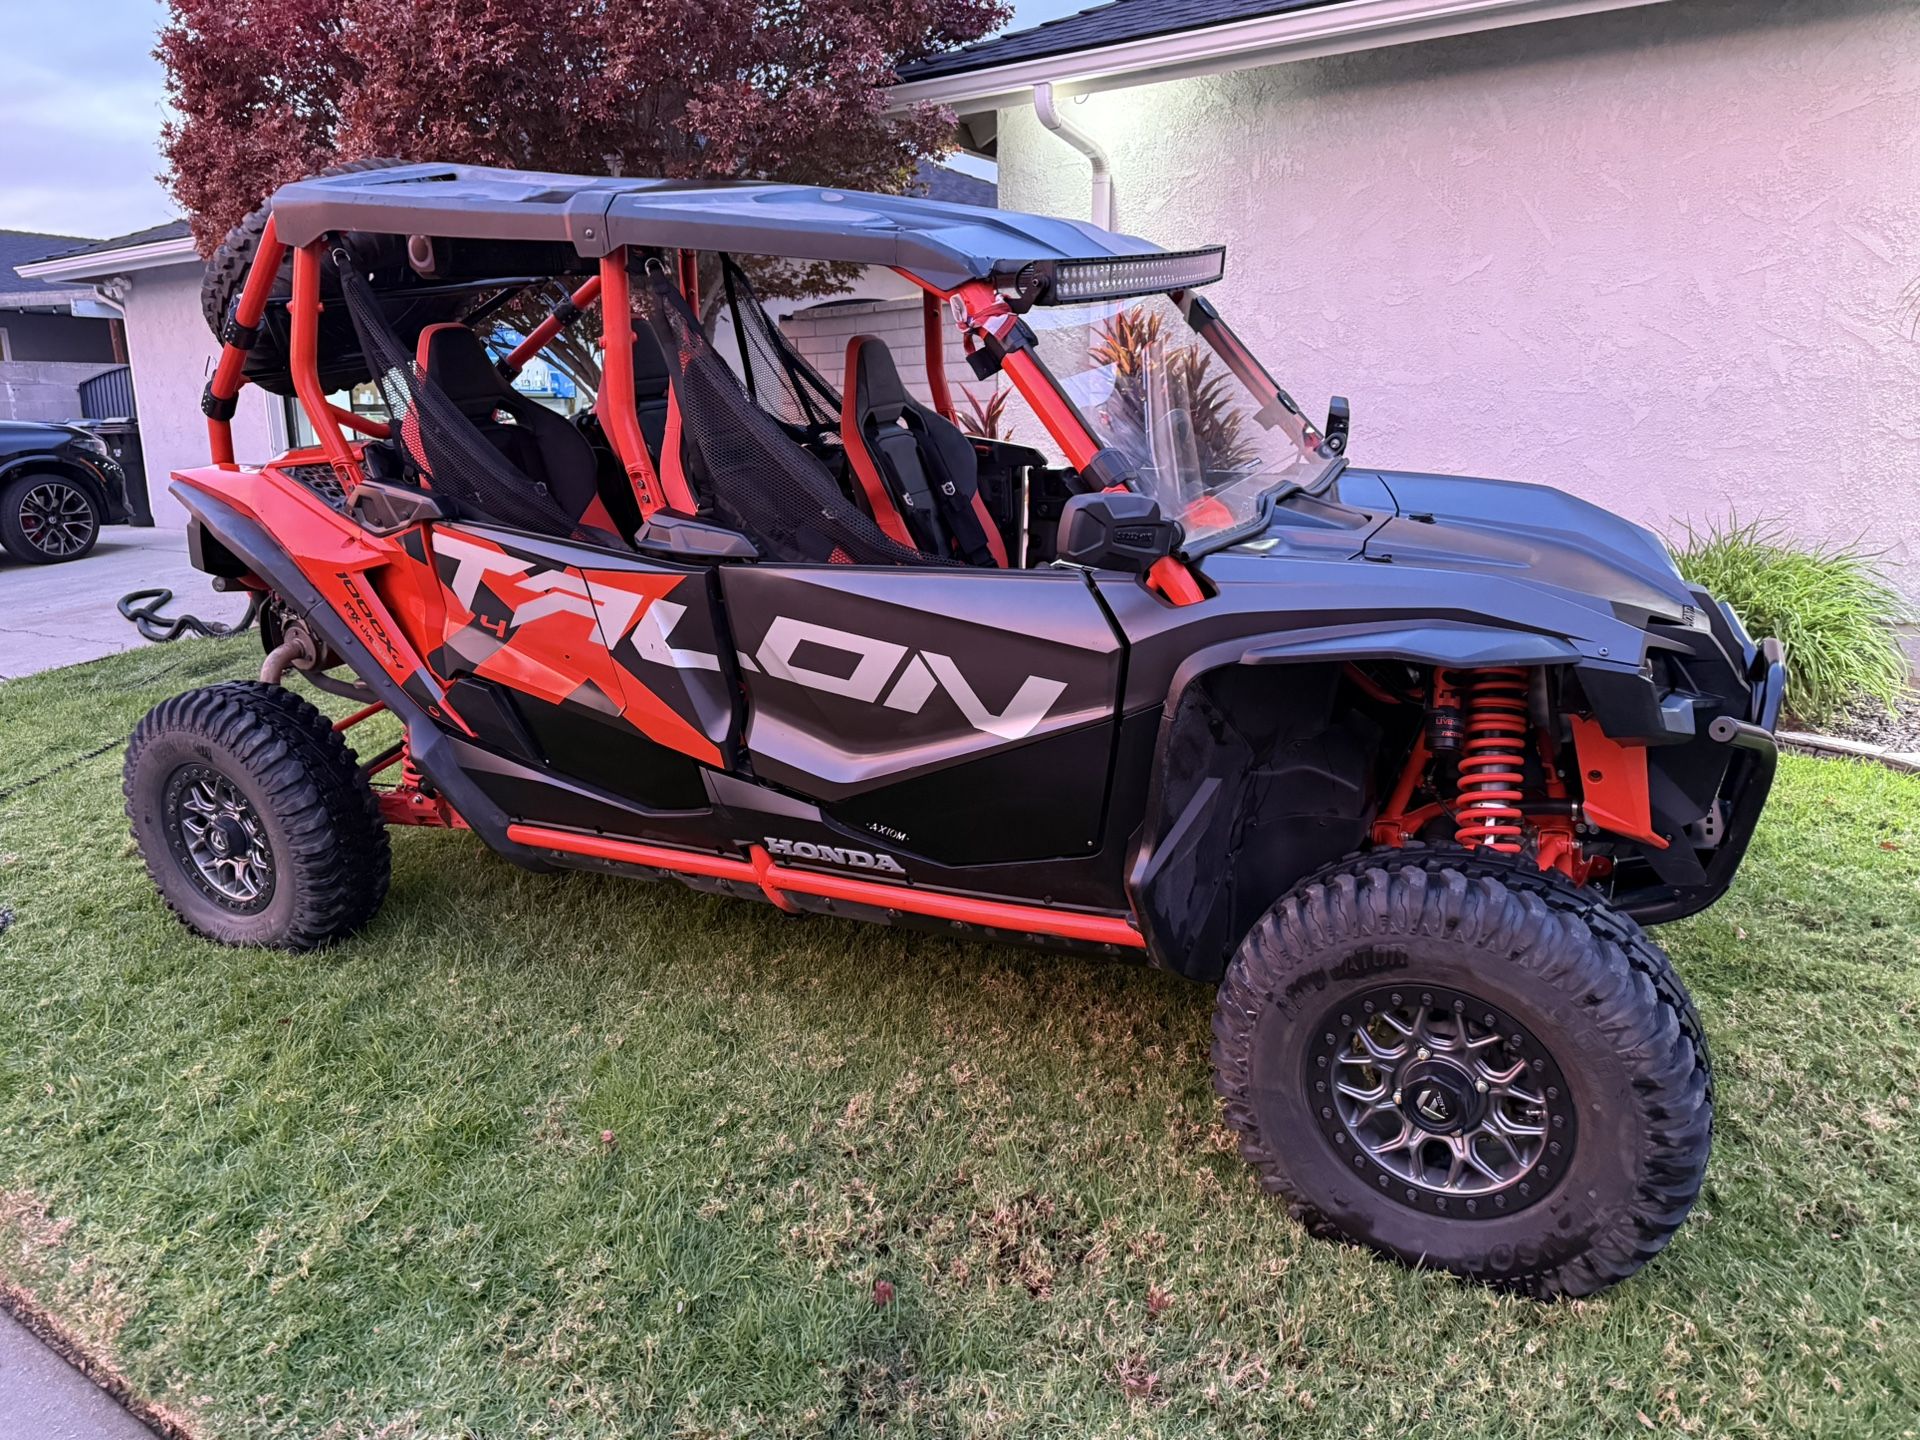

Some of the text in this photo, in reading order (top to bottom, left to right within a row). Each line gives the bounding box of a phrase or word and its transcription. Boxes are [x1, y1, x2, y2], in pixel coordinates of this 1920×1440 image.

[432, 531, 1067, 740] TALON
[480, 615, 507, 638] 4
[869, 822, 907, 841] AXIOM
[764, 837, 906, 873] HONDA
